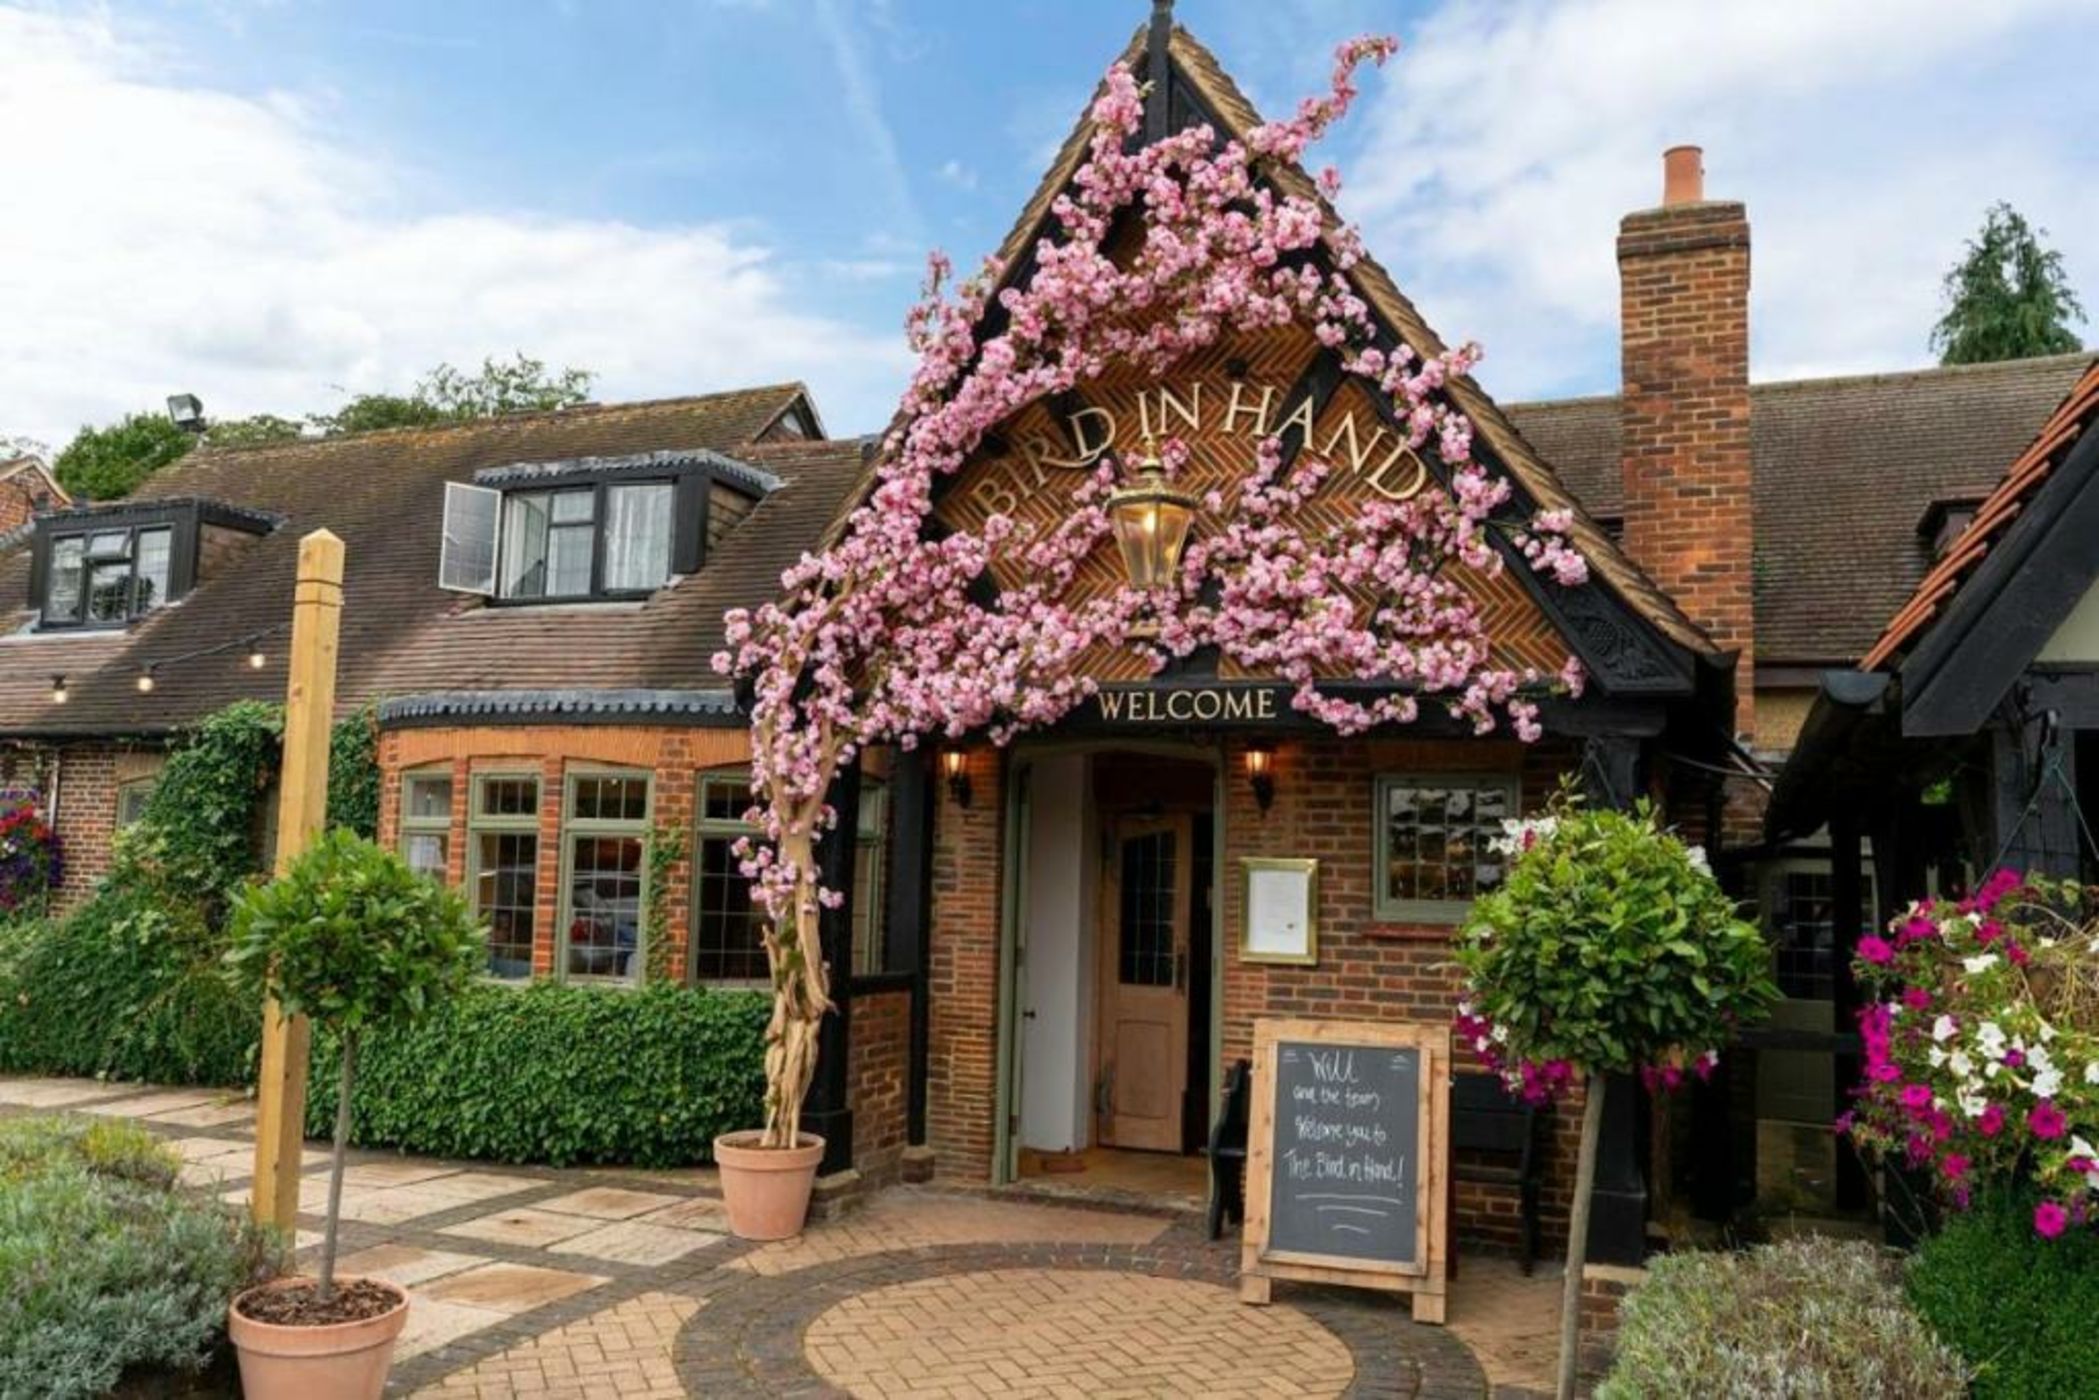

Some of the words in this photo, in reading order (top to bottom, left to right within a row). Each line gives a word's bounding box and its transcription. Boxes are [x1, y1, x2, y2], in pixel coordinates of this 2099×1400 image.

[970, 406, 1116, 516] BIRD
[1136, 382, 1202, 440] IN
[1220, 382, 1427, 500] HAND
[1098, 688, 1278, 721] WELCOME
[1307, 1050, 1360, 1084] Will
[1292, 1085, 1318, 1104] and
[1320, 1085, 1341, 1104] the
[1345, 1123, 1372, 1148] you
[1373, 1122, 1387, 1147] to
[1282, 1148, 1313, 1180] The
[1316, 1151, 1347, 1179] Bird
[1348, 1160, 1362, 1182] in
